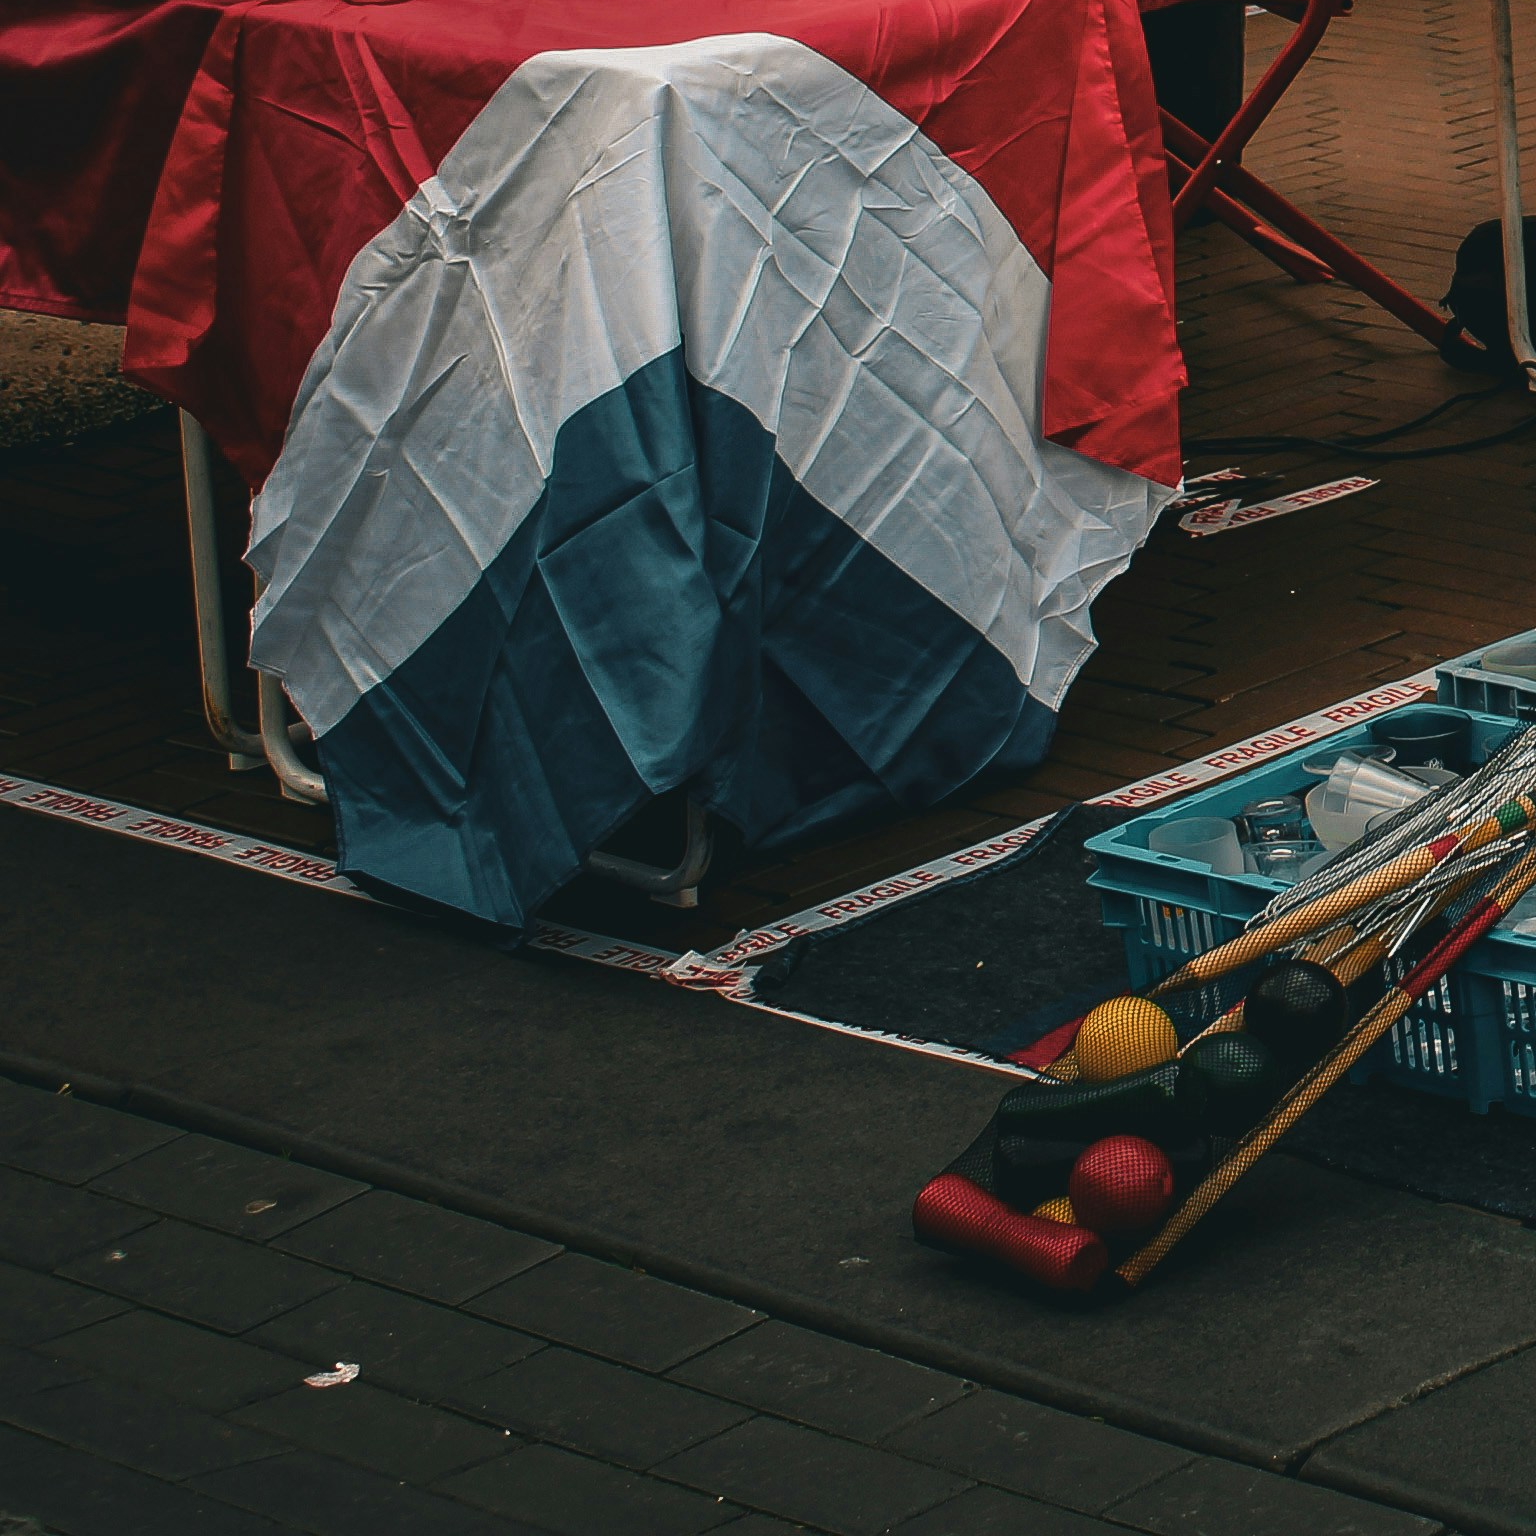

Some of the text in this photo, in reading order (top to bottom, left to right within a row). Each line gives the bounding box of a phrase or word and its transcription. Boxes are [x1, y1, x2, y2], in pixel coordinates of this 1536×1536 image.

[20, 789, 129, 822] FRAGILE
[127, 817, 236, 851] FRAGILE
[816, 680, 1432, 920] FRAGILE FRAGILE FRAGILE
